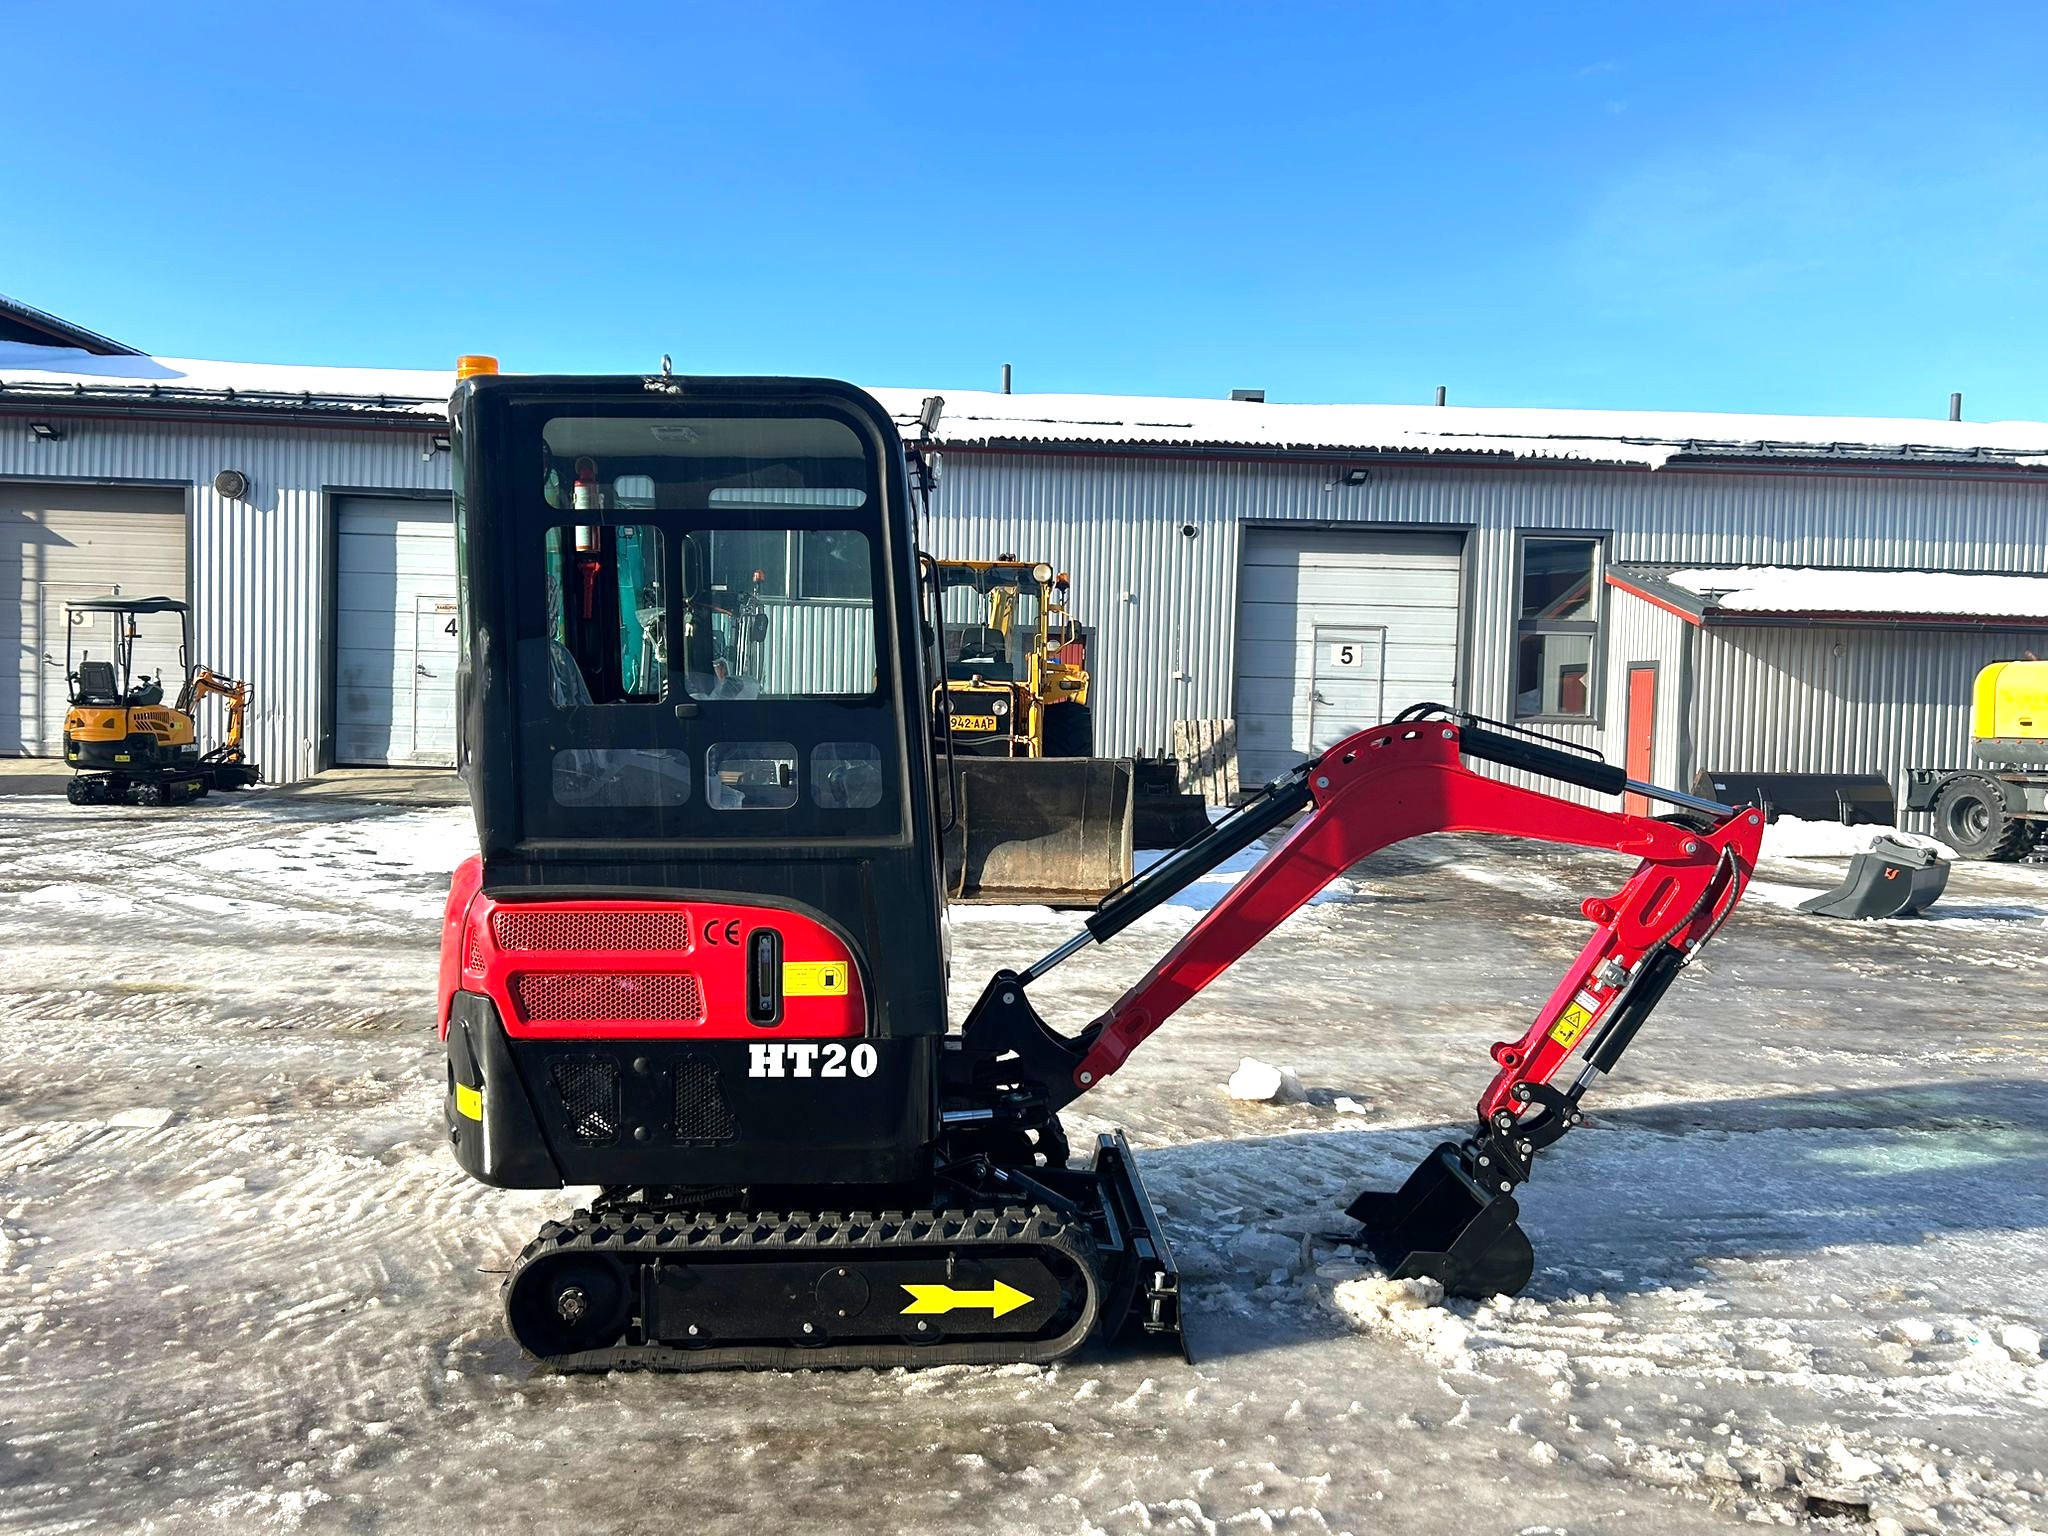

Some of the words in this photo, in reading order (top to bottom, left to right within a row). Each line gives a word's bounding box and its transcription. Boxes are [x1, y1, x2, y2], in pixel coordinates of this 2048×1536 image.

[71, 611, 84, 625] 3
[444, 618, 458, 637] 4
[1340, 646, 1354, 665] 5
[703, 919, 741, 946] CE
[748, 1043, 878, 1078] HT20
